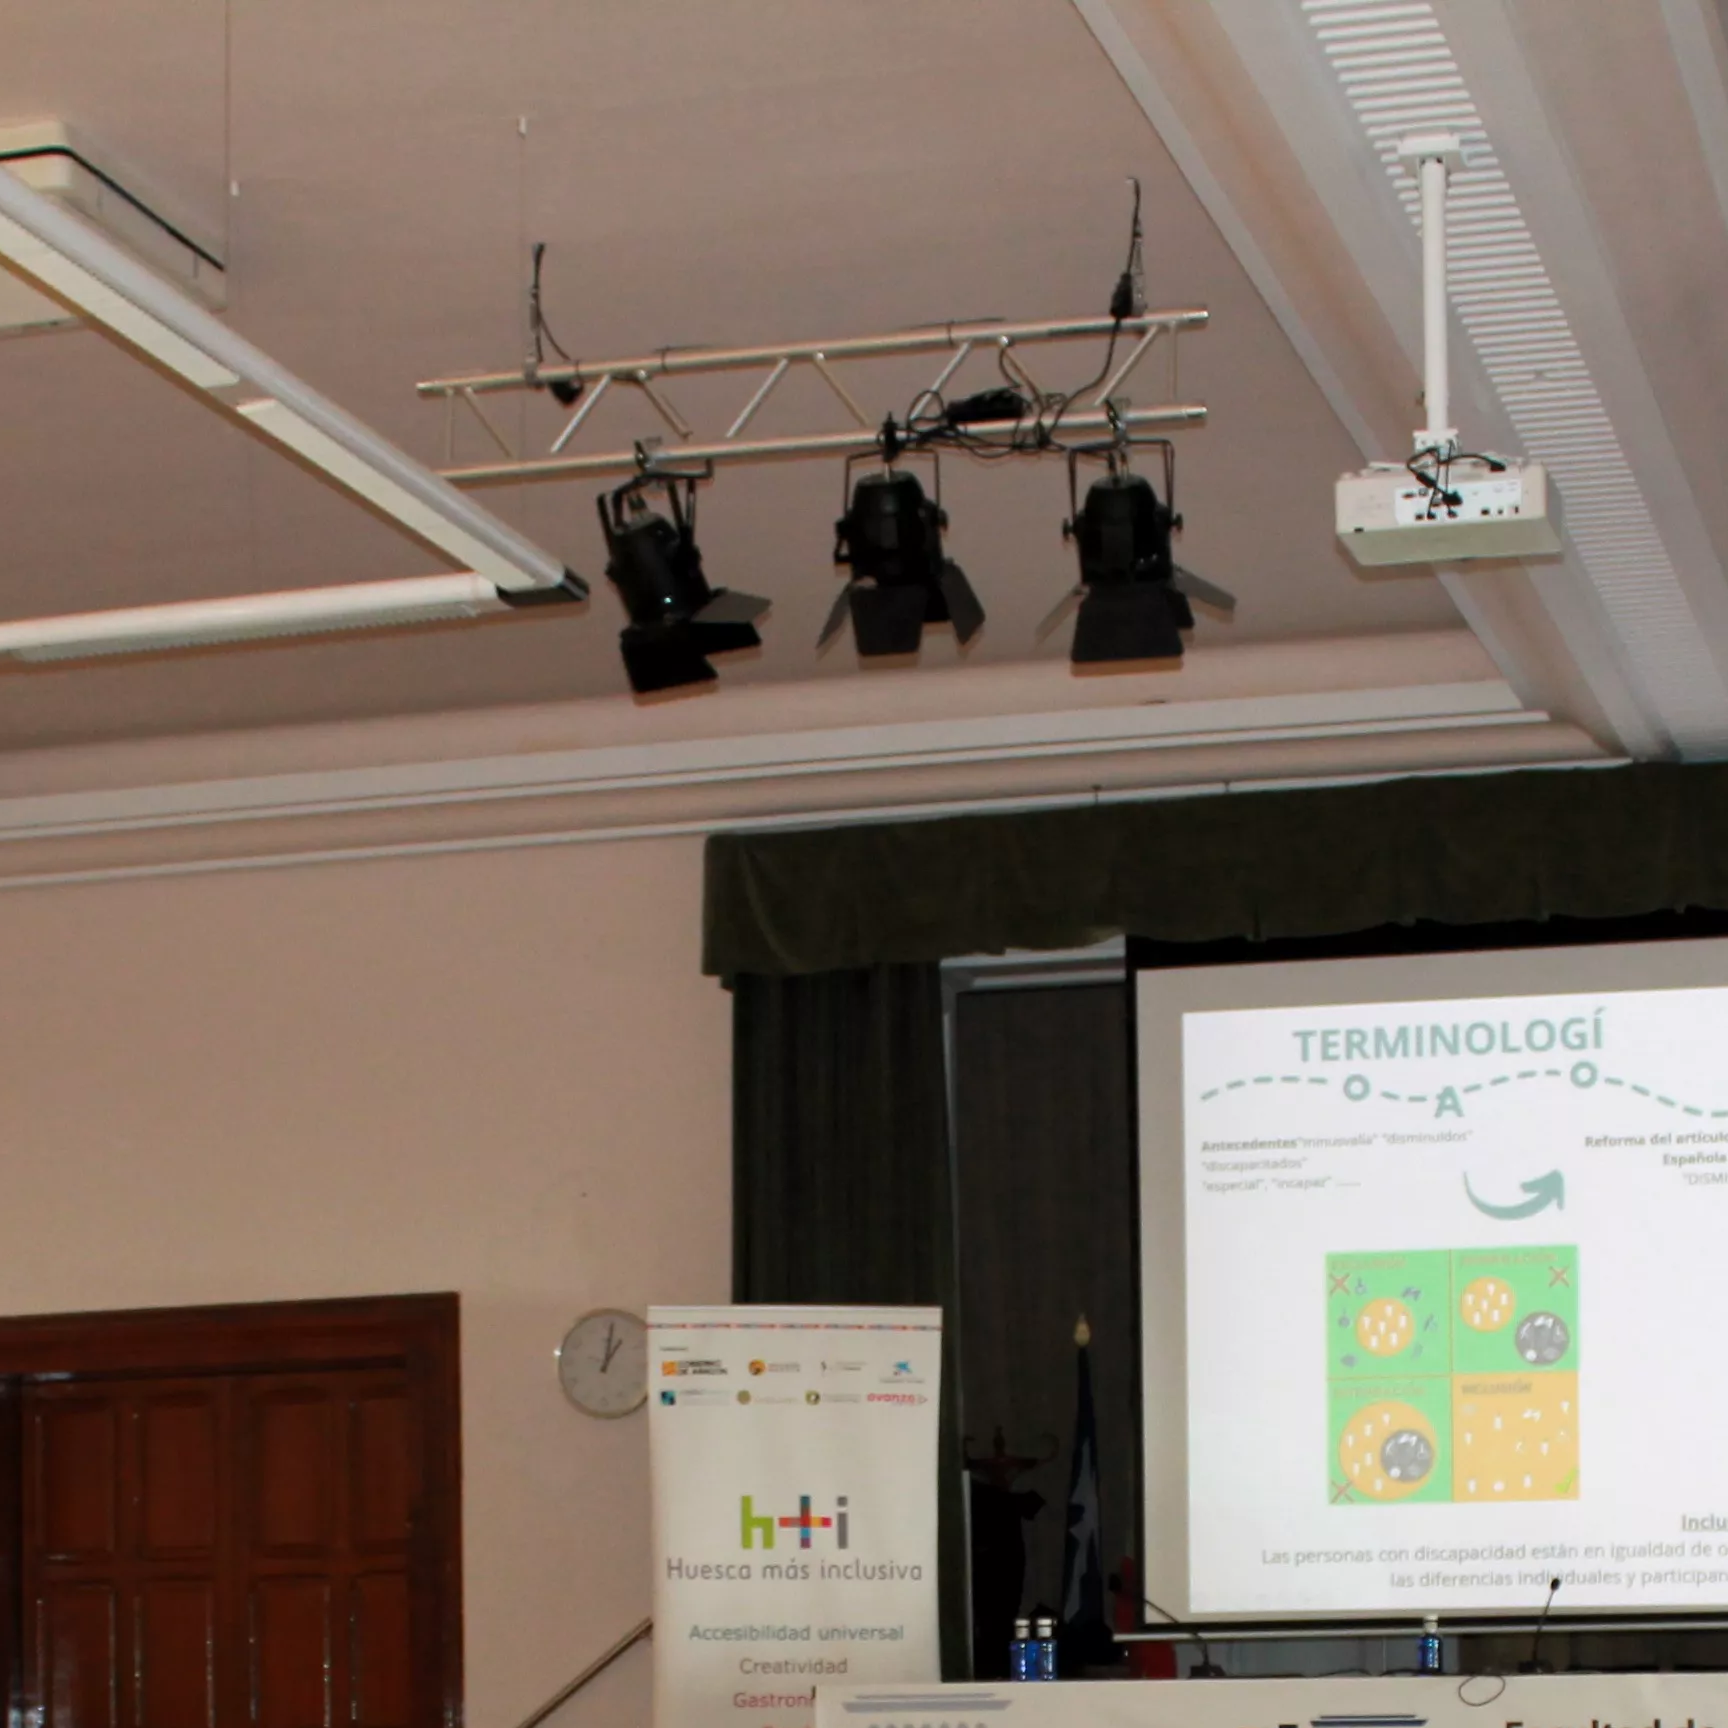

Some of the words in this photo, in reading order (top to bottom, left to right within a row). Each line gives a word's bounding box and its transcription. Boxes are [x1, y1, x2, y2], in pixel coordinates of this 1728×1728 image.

[1292, 1006, 1606, 1063] TERMINOLOGÍ
[1584, 1133, 1646, 1148] Reforma
[1650, 1131, 1672, 1146] del
[1662, 1151, 1728, 1168] Española
[1262, 1548, 1290, 1565] Las
[1295, 1549, 1373, 1568] personas
[1379, 1548, 1410, 1562] con
[1414, 1543, 1527, 1565] discapacidad
[1531, 1543, 1578, 1560] están
[1584, 1545, 1606, 1559] en
[1612, 1540, 1686, 1563] igualdad
[1692, 1540, 1713, 1557] de
[666, 1557, 752, 1581] Huesca
[761, 1557, 810, 1581] más
[821, 1556, 923, 1582] inclusiva
[1390, 1571, 1415, 1588] las
[1419, 1569, 1512, 1588] diferencias
[1626, 1574, 1635, 1589] y
[1641, 1568, 1728, 1588] participan
[689, 1624, 811, 1642] Accesibilidad
[818, 1623, 905, 1642] universal
[738, 1657, 849, 1676] Creatividad
[732, 1691, 817, 1710] Gastron
